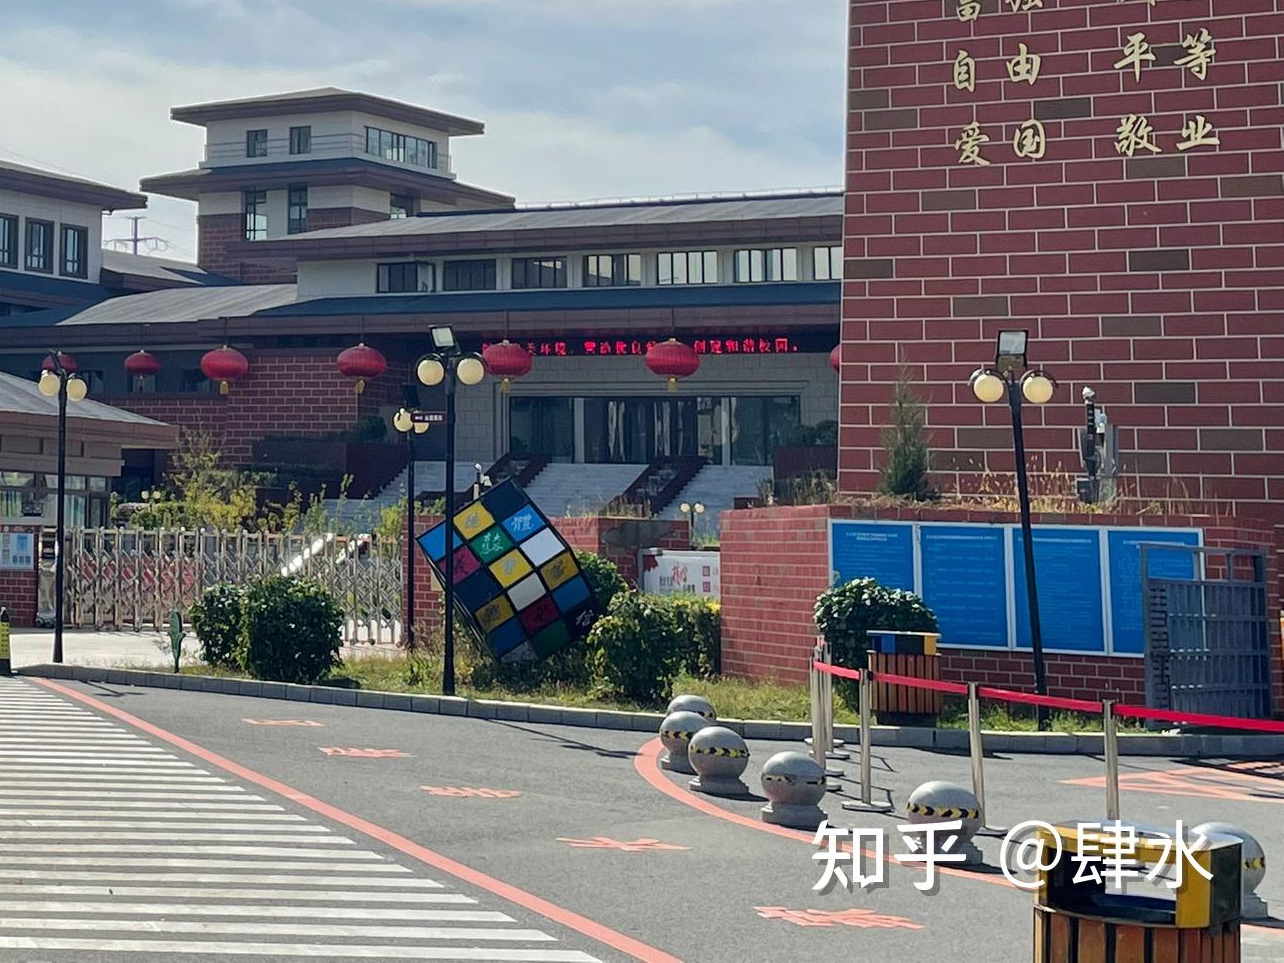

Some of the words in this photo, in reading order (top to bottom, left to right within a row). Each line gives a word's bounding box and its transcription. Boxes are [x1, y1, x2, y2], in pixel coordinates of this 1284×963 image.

[953, 44, 1041, 93] 自由
[1114, 28, 1218, 83] 平等
[954, 119, 1046, 167] 爱国
[1114, 113, 1221, 158] 敬业
